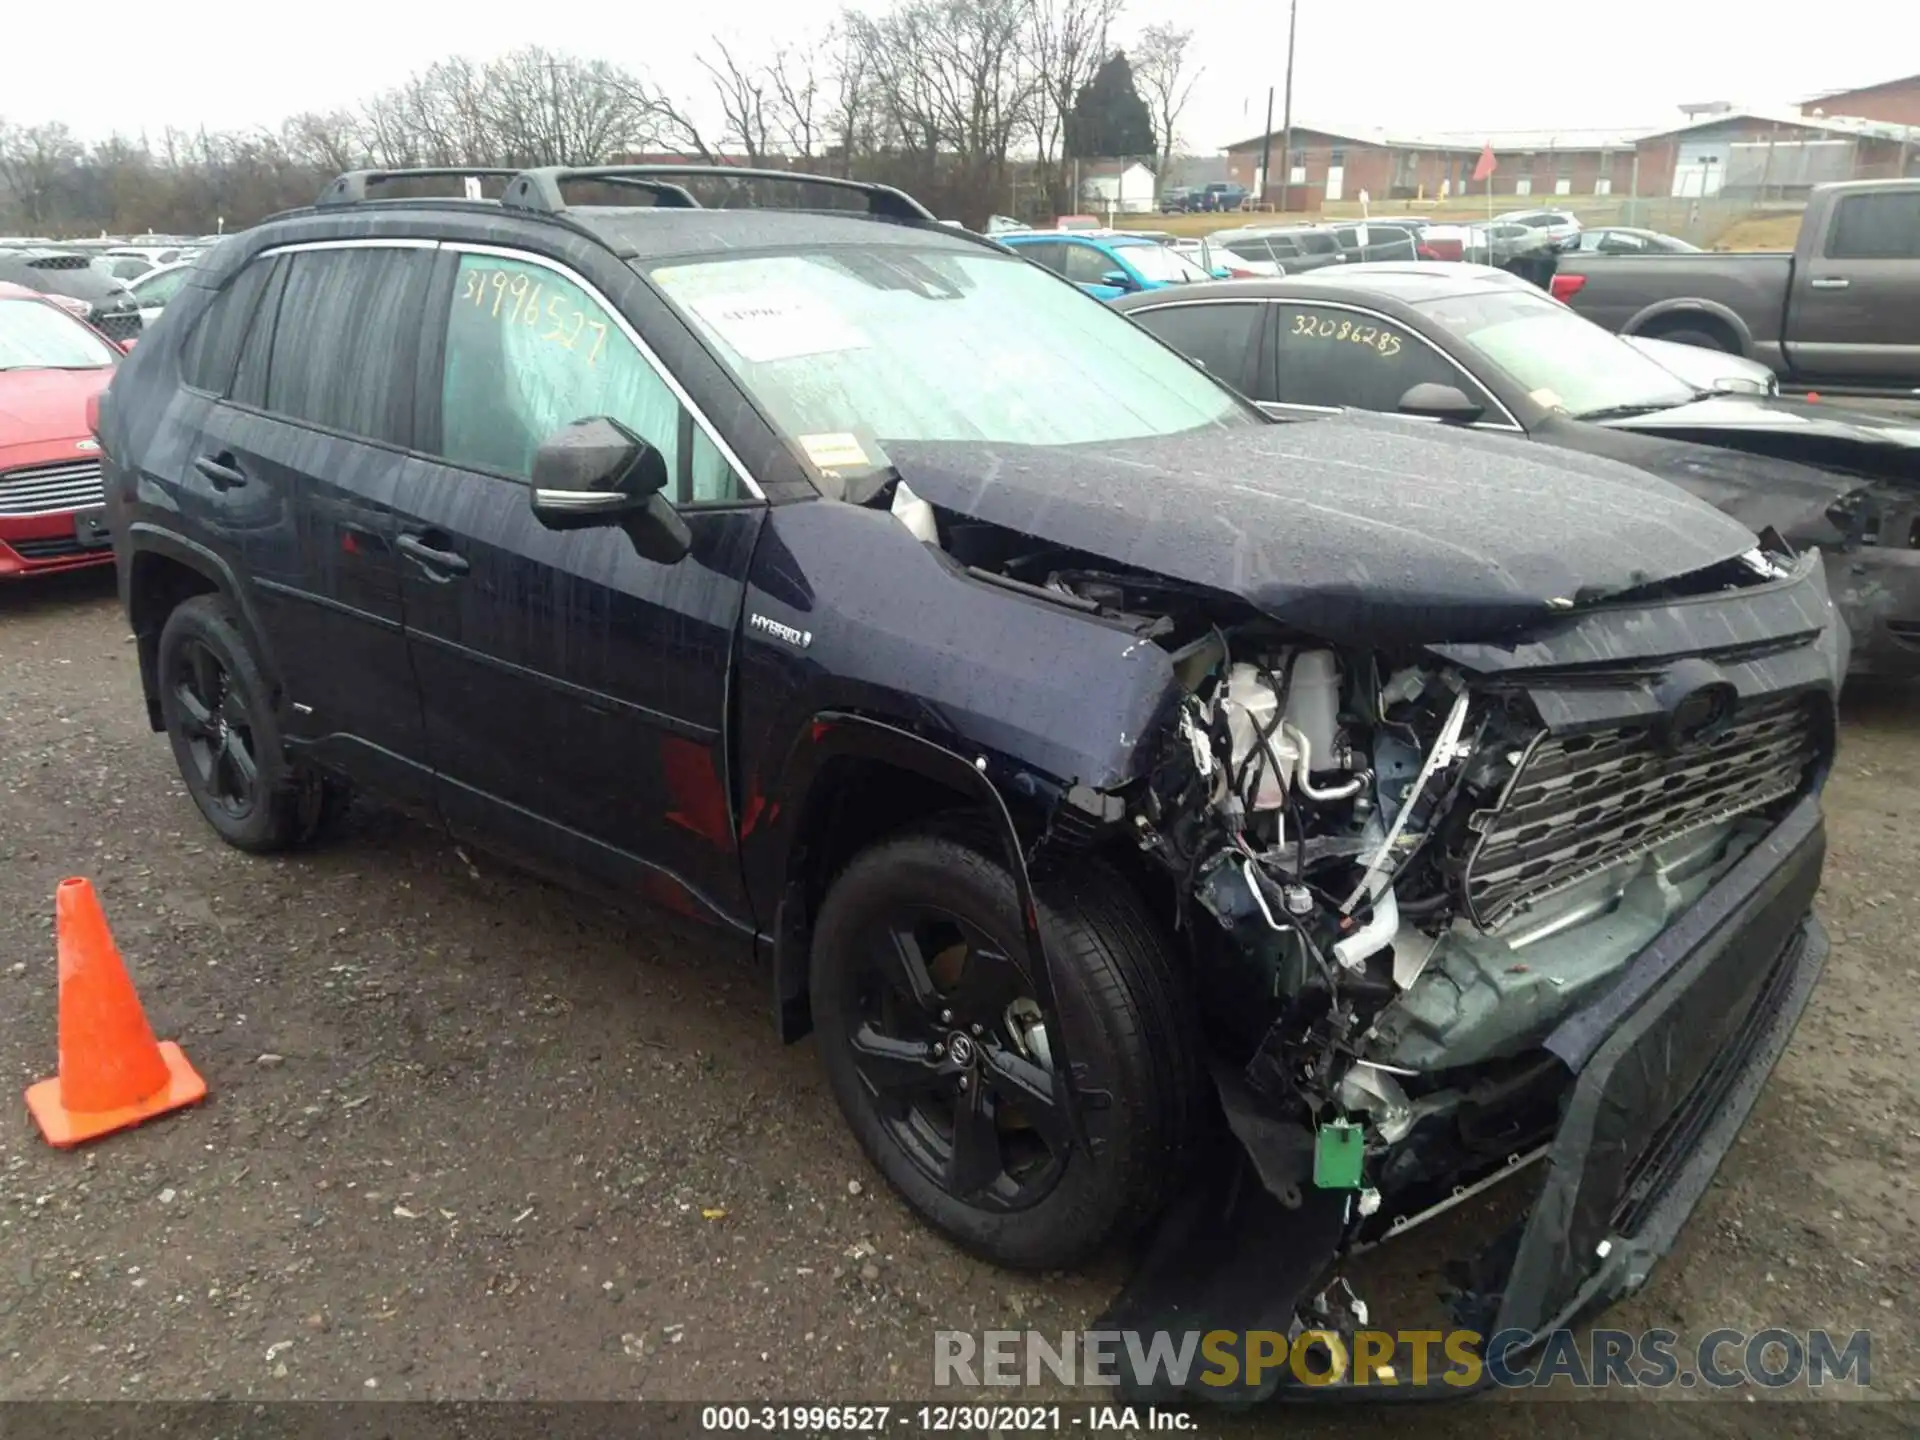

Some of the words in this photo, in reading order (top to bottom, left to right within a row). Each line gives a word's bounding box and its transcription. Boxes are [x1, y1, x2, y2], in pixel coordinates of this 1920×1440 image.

[461, 270, 607, 365] 31996527
[1291, 315, 1401, 356] 32086285
[750, 612, 802, 645] HYBRID
